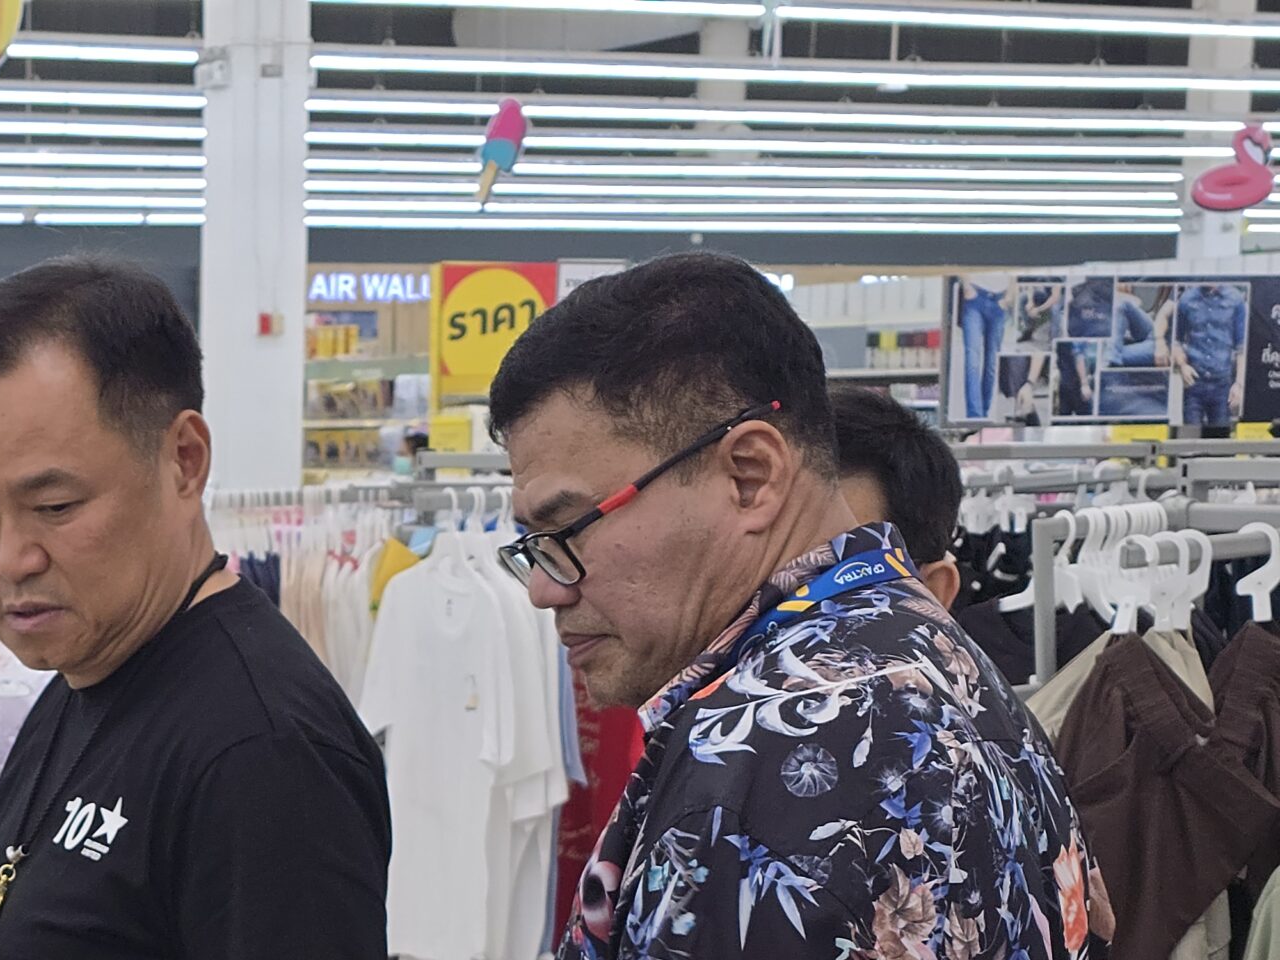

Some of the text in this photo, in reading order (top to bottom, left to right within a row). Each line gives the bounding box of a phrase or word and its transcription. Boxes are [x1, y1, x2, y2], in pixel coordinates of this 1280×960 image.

[310, 273, 357, 300] AIR
[448, 299, 538, 341] ราคา
[834, 565, 873, 585] AXTRA
